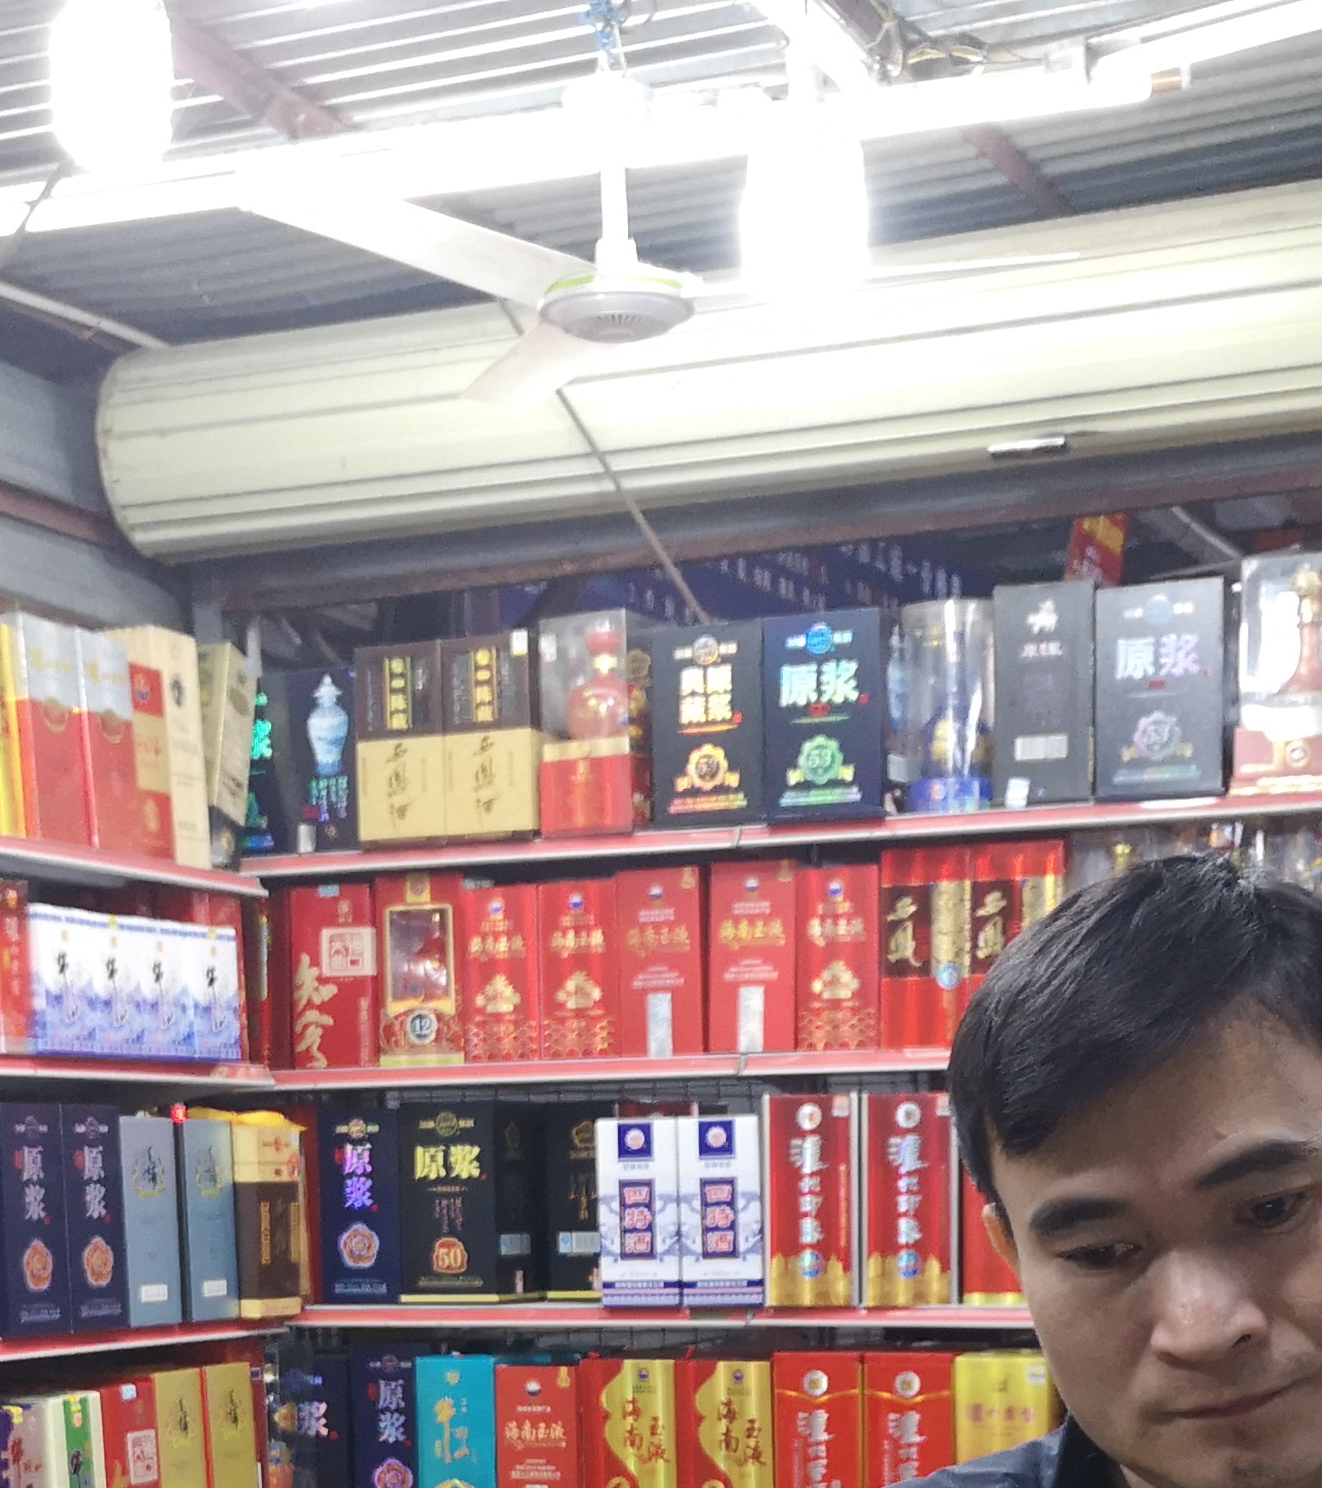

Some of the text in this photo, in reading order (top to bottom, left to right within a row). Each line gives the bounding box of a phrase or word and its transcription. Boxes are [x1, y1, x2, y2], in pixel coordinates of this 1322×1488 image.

[1116, 632, 1201, 681] 原浆
[779, 658, 860, 708] 原浆
[415, 1144, 481, 1181] 原浆
[378, 1378, 407, 1444] 原浆
